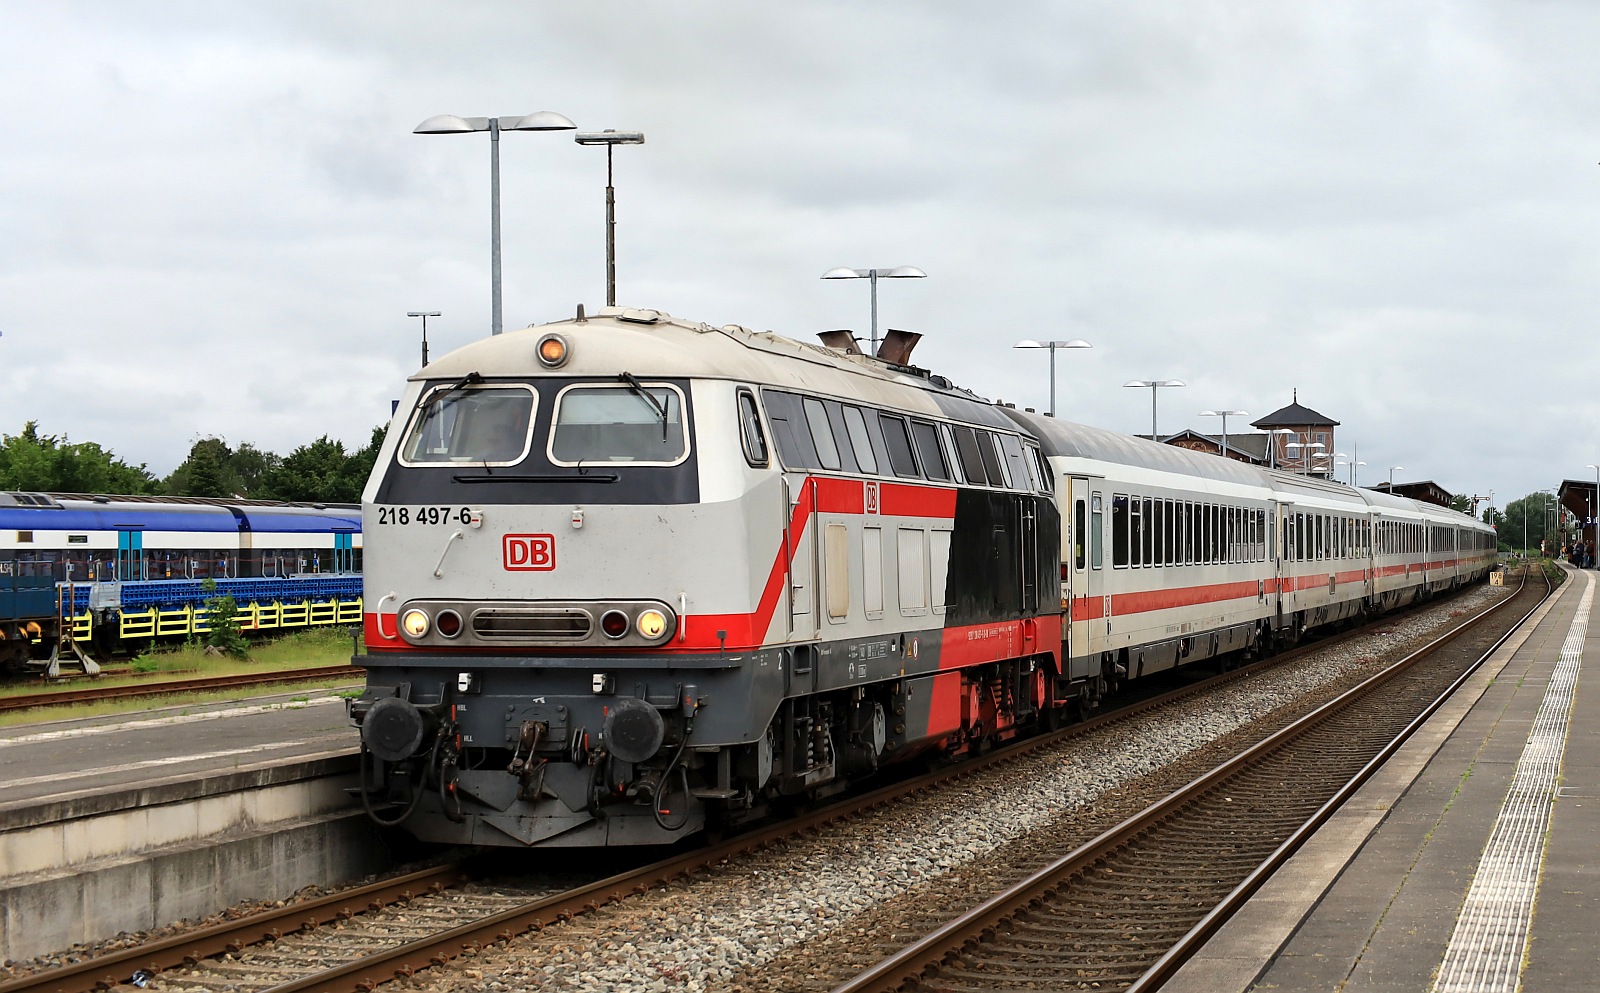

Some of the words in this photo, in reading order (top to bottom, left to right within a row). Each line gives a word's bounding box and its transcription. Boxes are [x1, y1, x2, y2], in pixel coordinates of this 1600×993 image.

[867, 486, 876, 509] DB
[378, 507, 410, 525] 218
[416, 507, 472, 525] 497-6
[1586, 516, 1592, 524] 3
[508, 539, 550, 566] DB
[777, 652, 783, 670] 2
